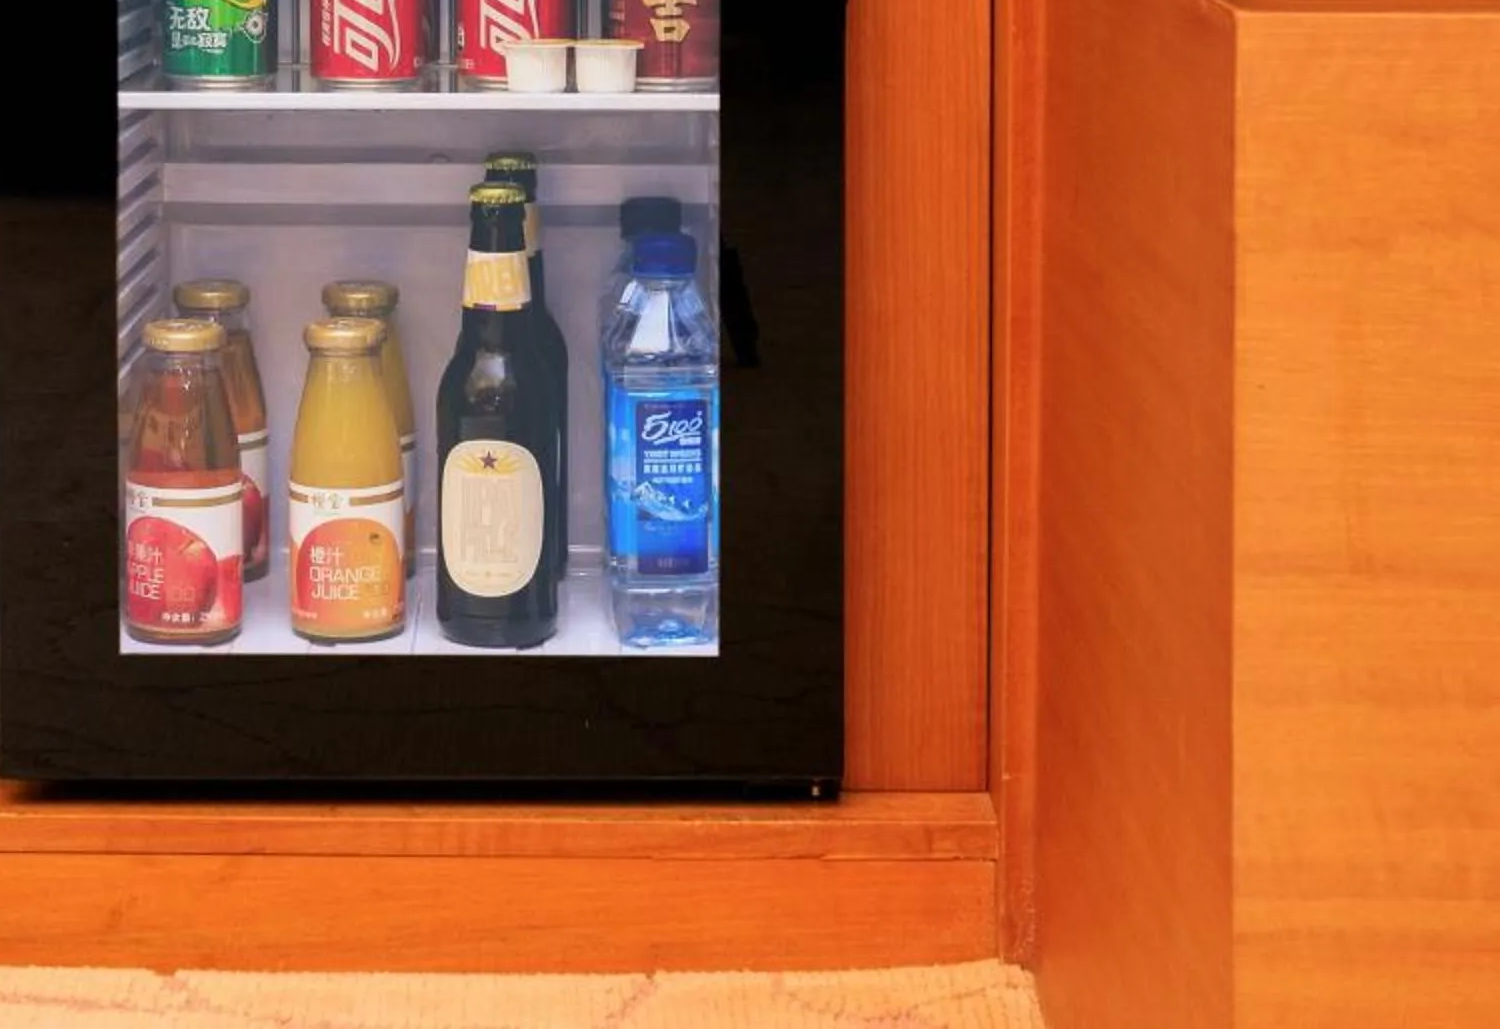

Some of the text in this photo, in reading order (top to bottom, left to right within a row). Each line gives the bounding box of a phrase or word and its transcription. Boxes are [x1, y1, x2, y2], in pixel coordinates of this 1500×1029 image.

[169, 7, 210, 31] 无敌
[642, 411, 703, 442] 5100
[310, 545, 343, 565] 橙汁
[309, 565, 381, 584] ORANGE
[311, 583, 359, 600] JUICE
